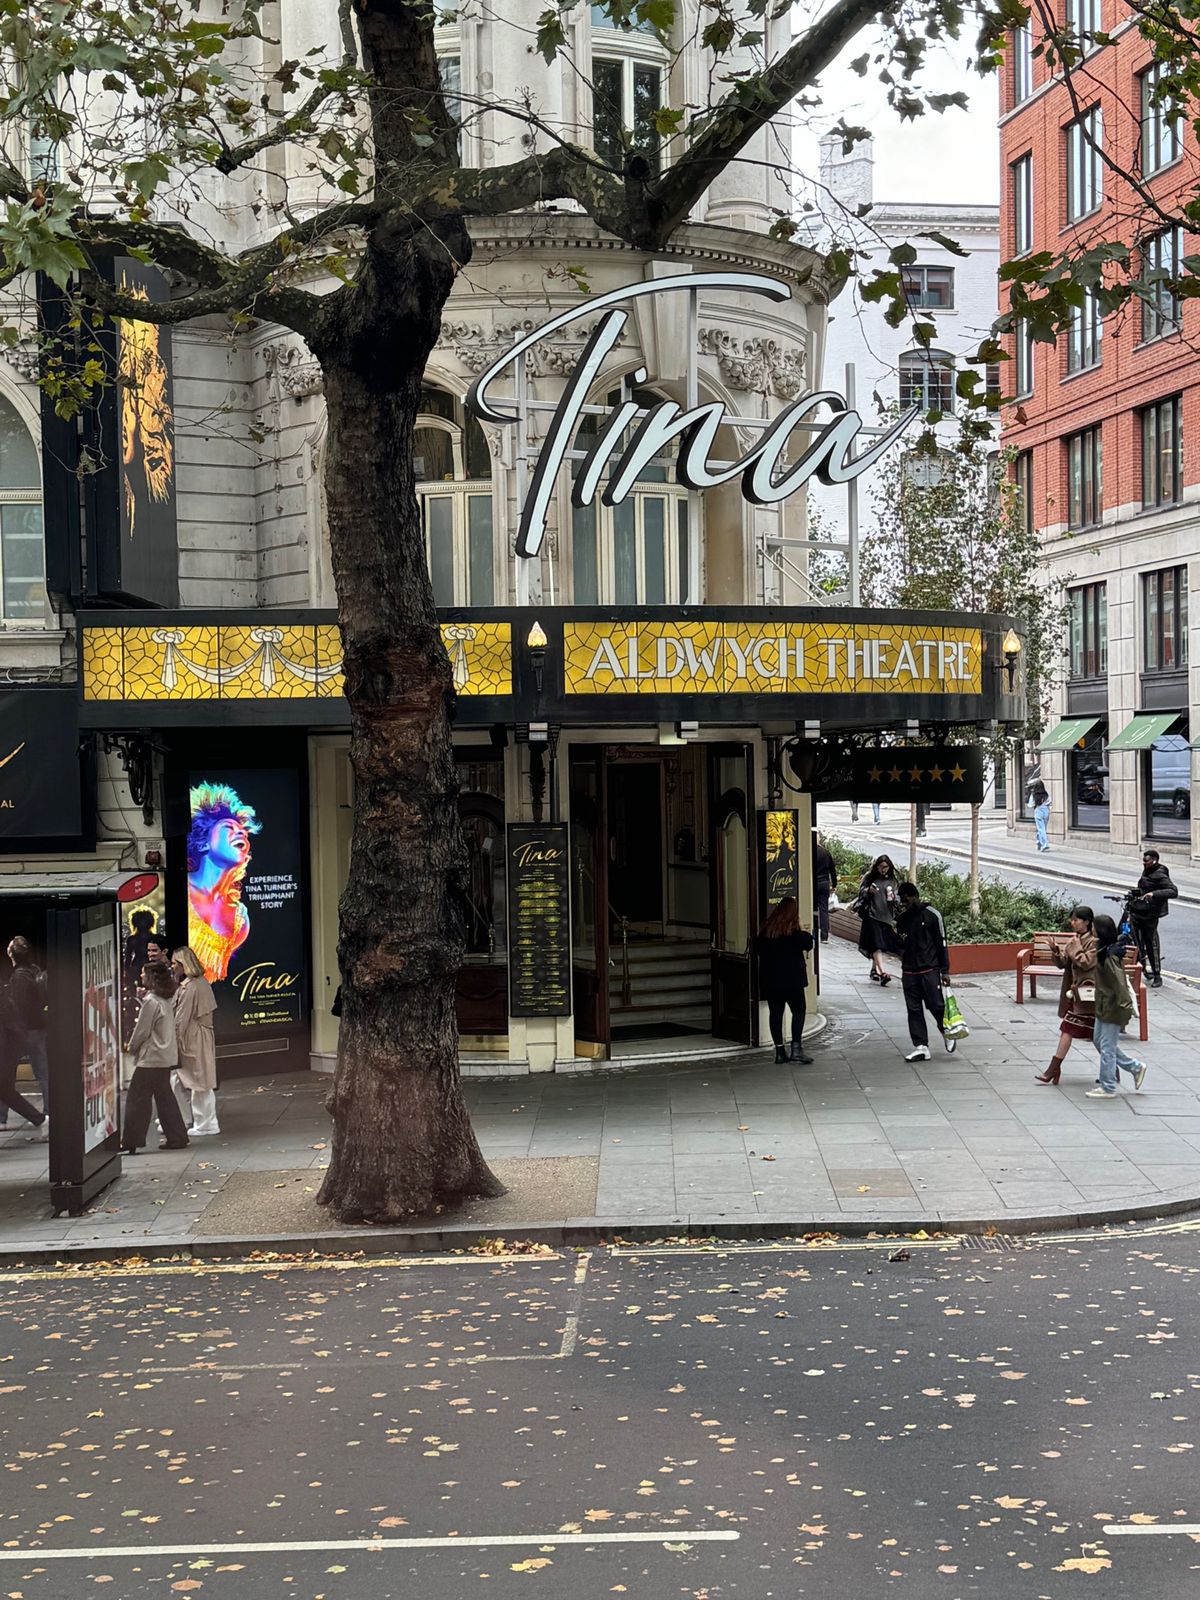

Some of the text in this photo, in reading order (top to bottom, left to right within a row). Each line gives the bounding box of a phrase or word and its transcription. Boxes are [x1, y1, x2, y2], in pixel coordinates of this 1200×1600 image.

[467, 271, 920, 558] Tina
[585, 636, 973, 680] ALDWYCH THEATRE
[512, 841, 564, 868] Tina
[245, 882, 298, 893] TINA TURNER'S
[249, 874, 293, 884] EXPERIENCE
[248, 891, 295, 901] TRIUMPHANT
[260, 901, 284, 910] STORY
[84, 940, 112, 989] DRINK
[231, 962, 300, 1002] Tina
